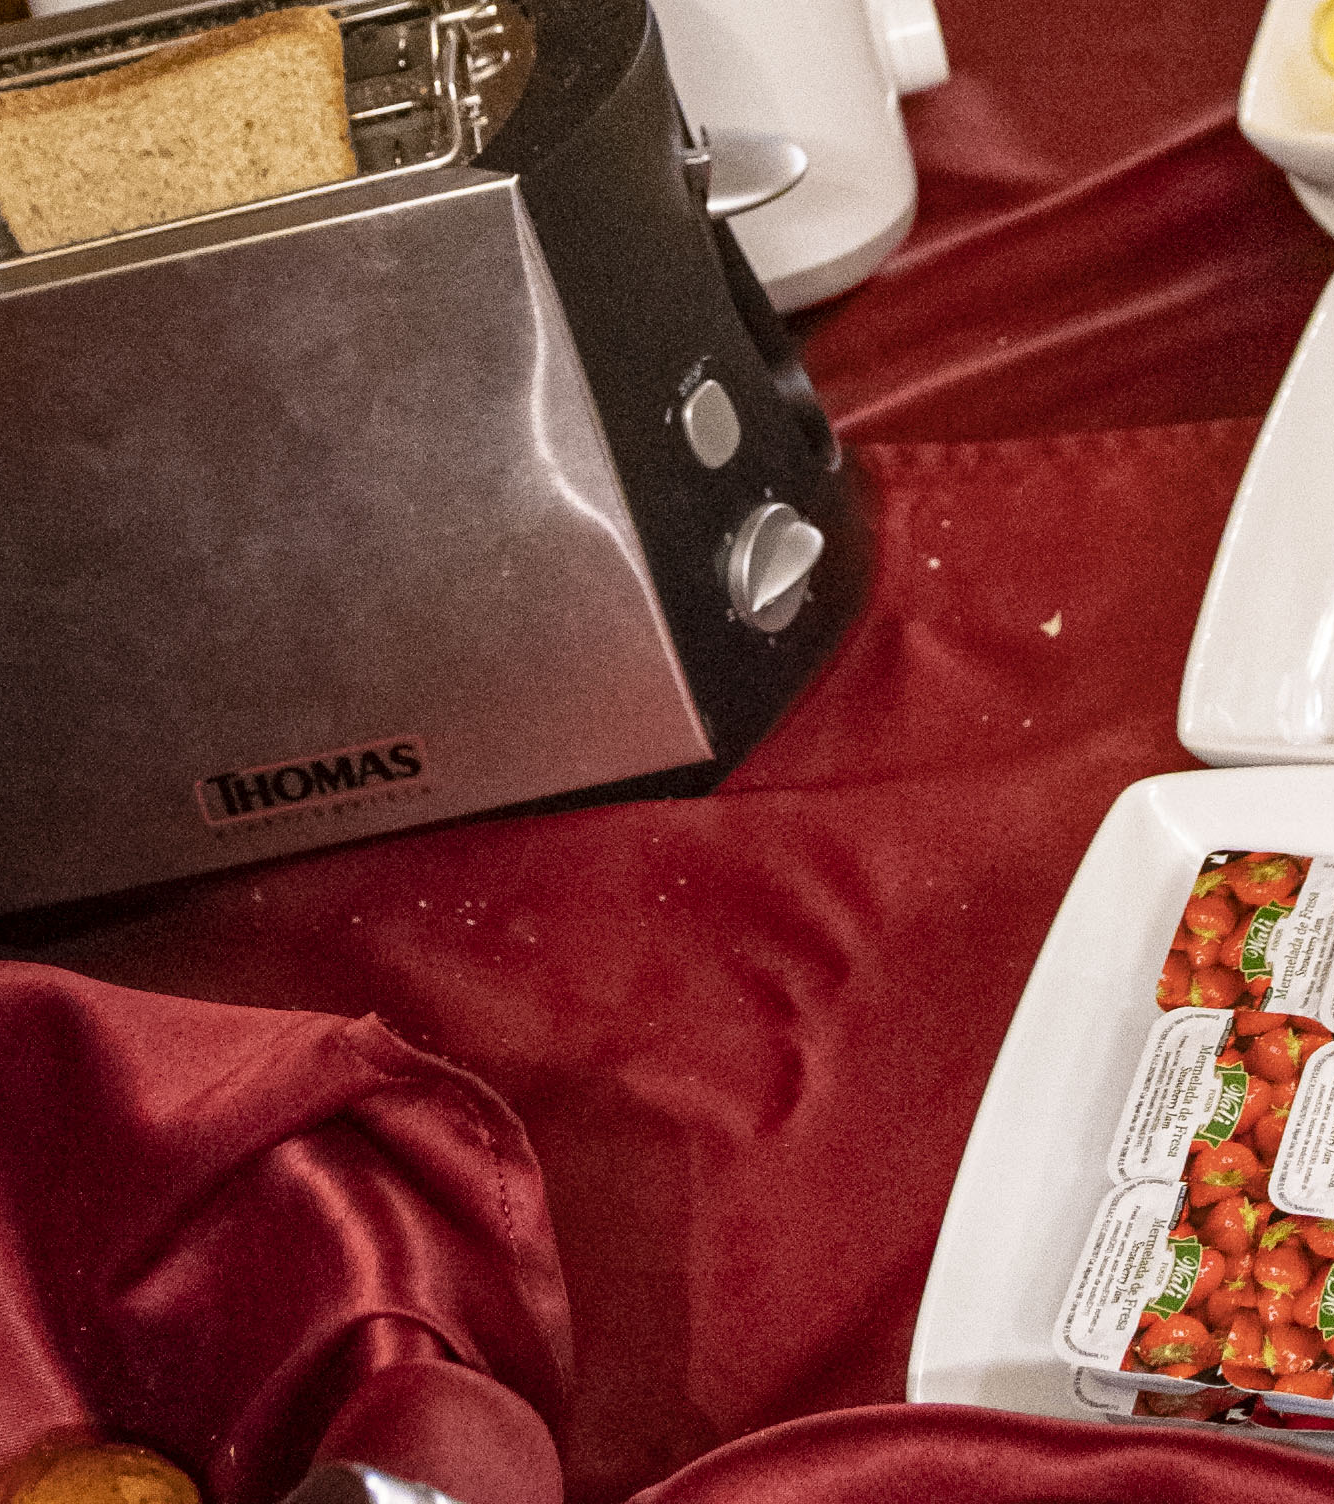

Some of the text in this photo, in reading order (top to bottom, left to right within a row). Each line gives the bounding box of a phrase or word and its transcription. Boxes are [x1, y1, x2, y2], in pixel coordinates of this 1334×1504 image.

[208, 744, 423, 817] THOMAS
[1271, 891, 1320, 1001] Mermelada de Fresa
[1309, 917, 1325, 936] Jam
[1161, 1111, 1178, 1130] Jam
[1167, 1044, 1214, 1158] Mermelada de Fresa
[1110, 1286, 1128, 1305] Jam
[1115, 1217, 1167, 1332] Mermelada de Fresa
